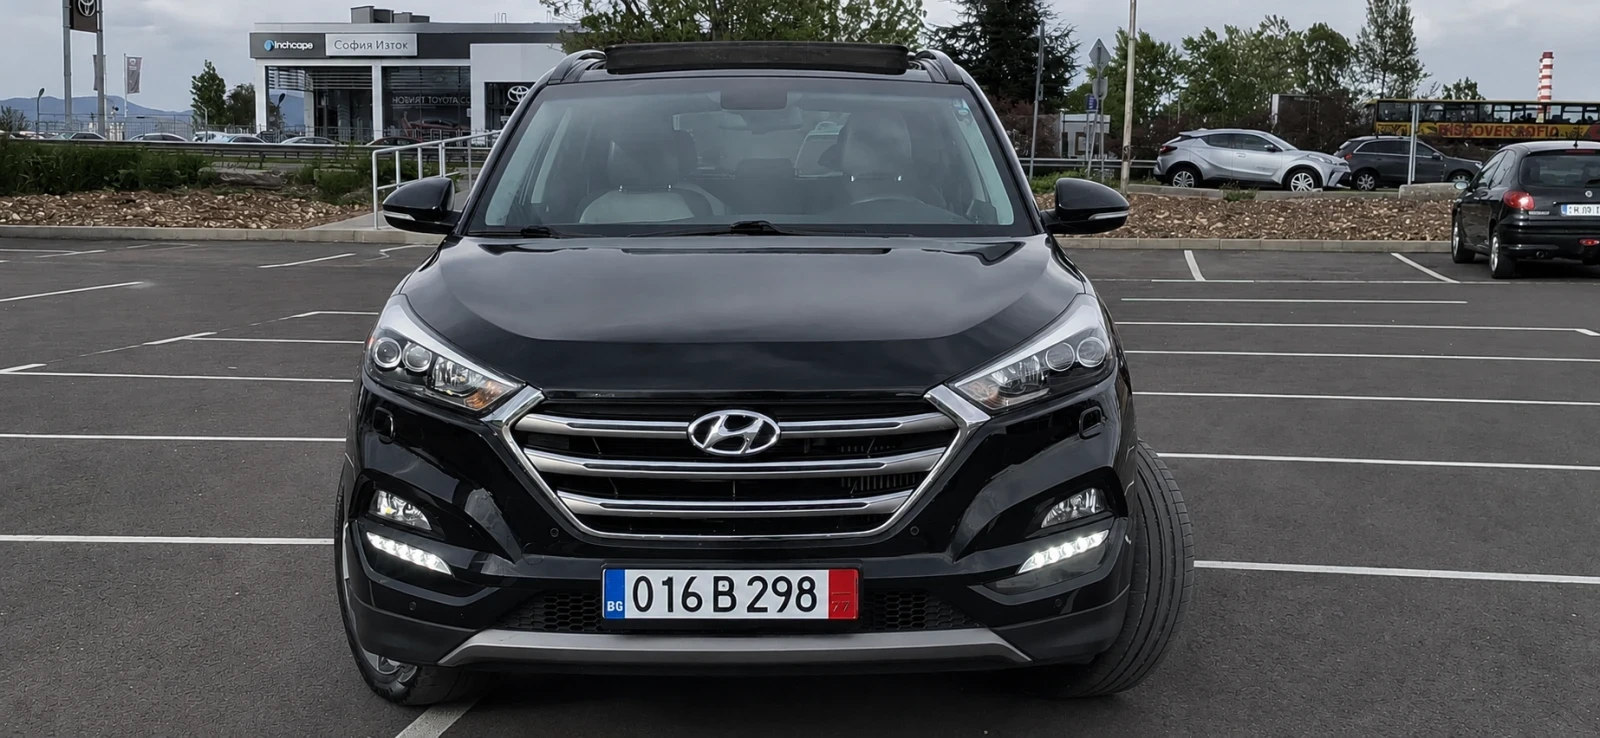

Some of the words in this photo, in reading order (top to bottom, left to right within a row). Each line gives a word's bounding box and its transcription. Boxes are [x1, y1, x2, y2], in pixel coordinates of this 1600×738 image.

[274, 40, 313, 51] Inchcape
[334, 39, 372, 52] София
[376, 40, 408, 50] Изток
[428, 96, 459, 104] TOYOTA
[632, 575, 703, 613] 016
[713, 576, 737, 613] B
[746, 575, 817, 613] 298
[607, 601, 623, 612] BG
